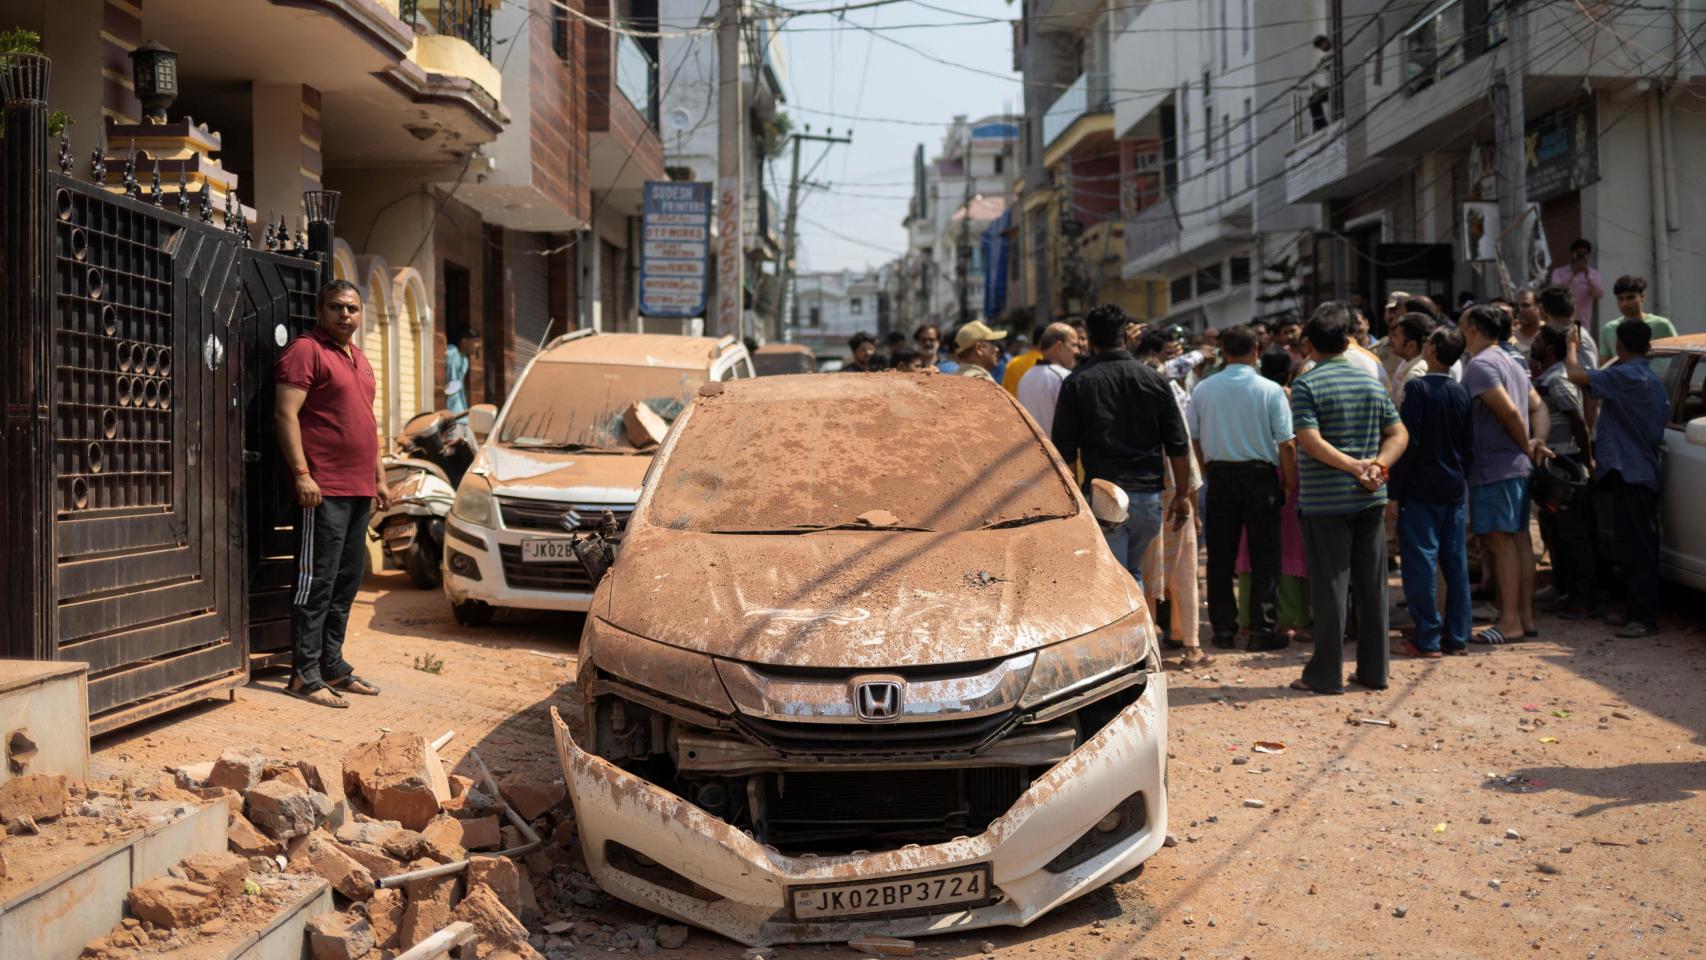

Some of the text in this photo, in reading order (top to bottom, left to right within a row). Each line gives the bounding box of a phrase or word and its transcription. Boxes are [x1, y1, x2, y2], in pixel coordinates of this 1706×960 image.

[652, 186, 693, 201] SUDESH
[661, 200, 706, 213] PRINTERS
[532, 543, 573, 558] JK02B
[816, 874, 981, 911] JK02BP3724
